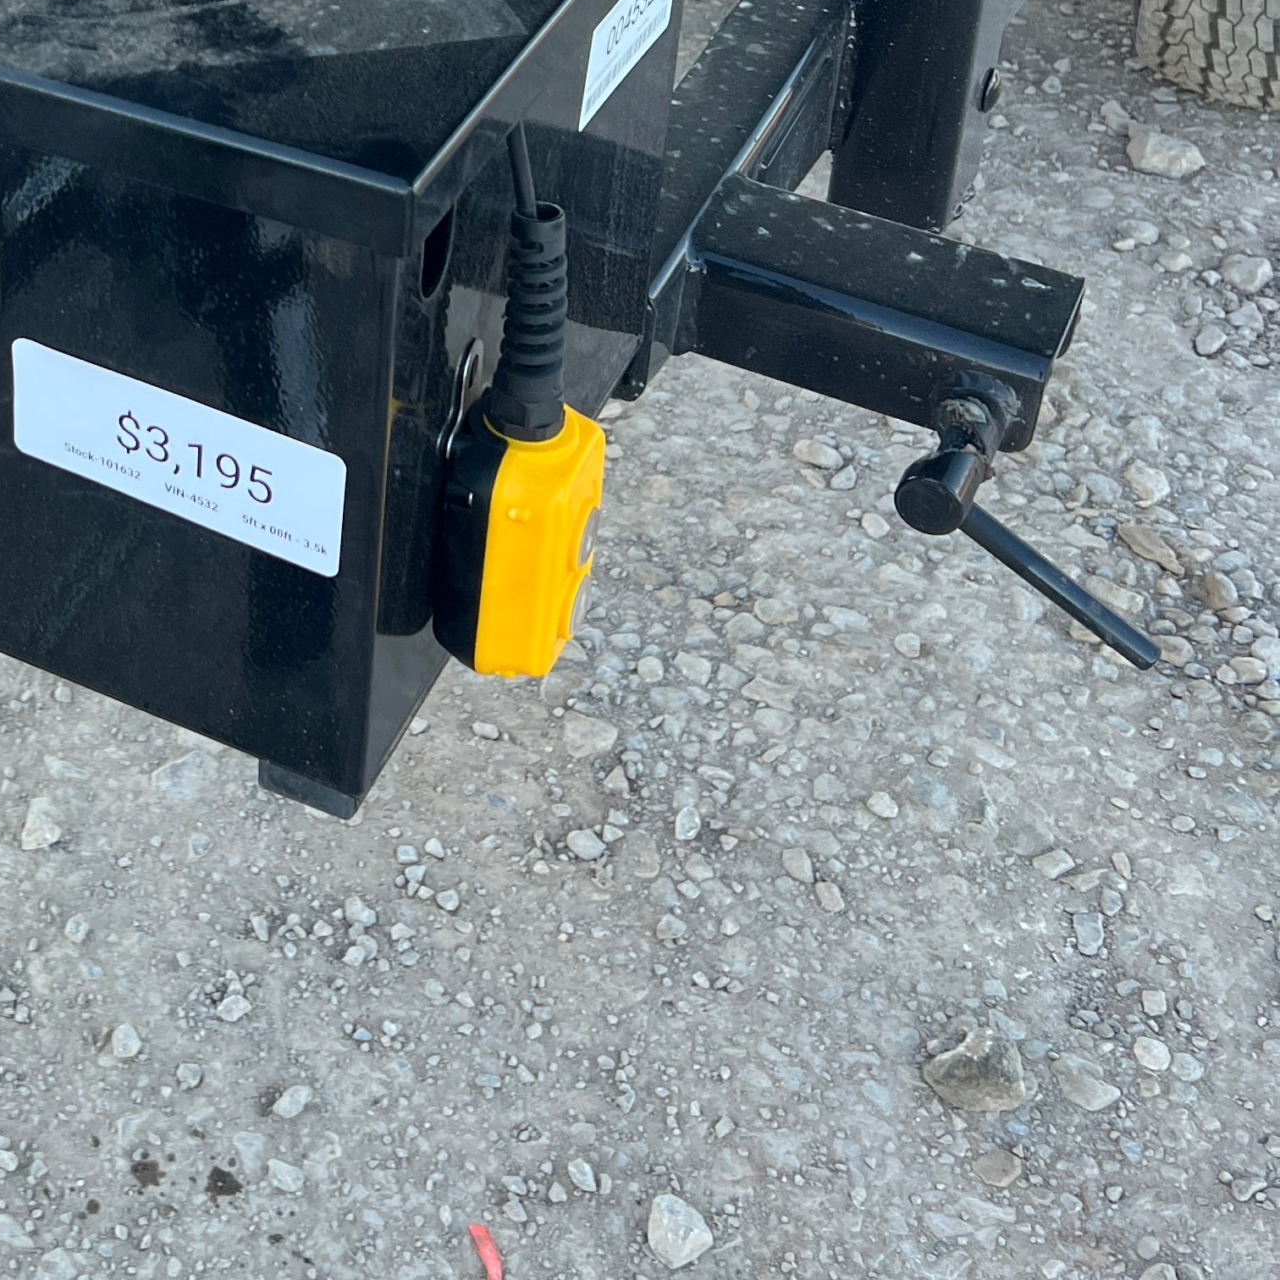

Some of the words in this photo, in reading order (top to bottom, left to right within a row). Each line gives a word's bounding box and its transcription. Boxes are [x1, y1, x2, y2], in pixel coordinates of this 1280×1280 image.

[63, 441, 141, 481] Stock-101632
[164, 482, 220, 513] VIN-4532
[242, 514, 258, 528] 5ft
[303, 539, 328, 556] 3.5k
[116, 409, 273, 504] $3,195
